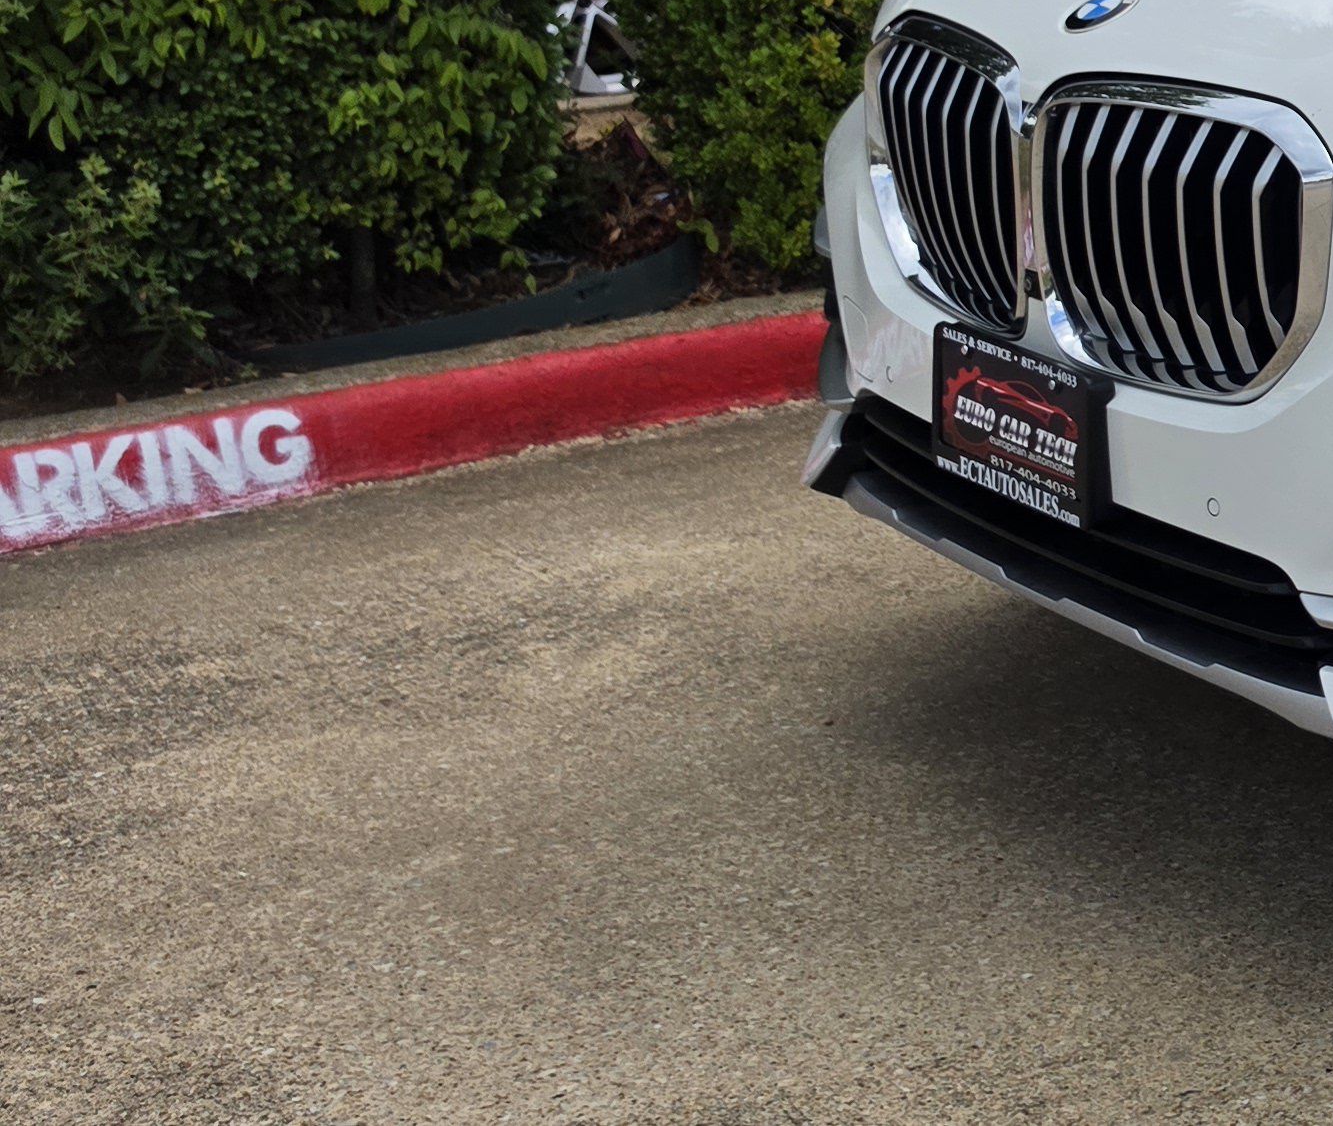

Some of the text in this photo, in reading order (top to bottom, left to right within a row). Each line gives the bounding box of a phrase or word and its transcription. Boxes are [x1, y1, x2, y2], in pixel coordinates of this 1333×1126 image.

[943, 327, 1077, 388] SALES & SERVICE 817-404-4033
[954, 395, 1078, 467] EURO CAR TECH
[988, 435, 1076, 478] european automotive
[936, 455, 1081, 528] www.ECTAUTOSALES.com
[990, 455, 1077, 500] 817-404-4033
